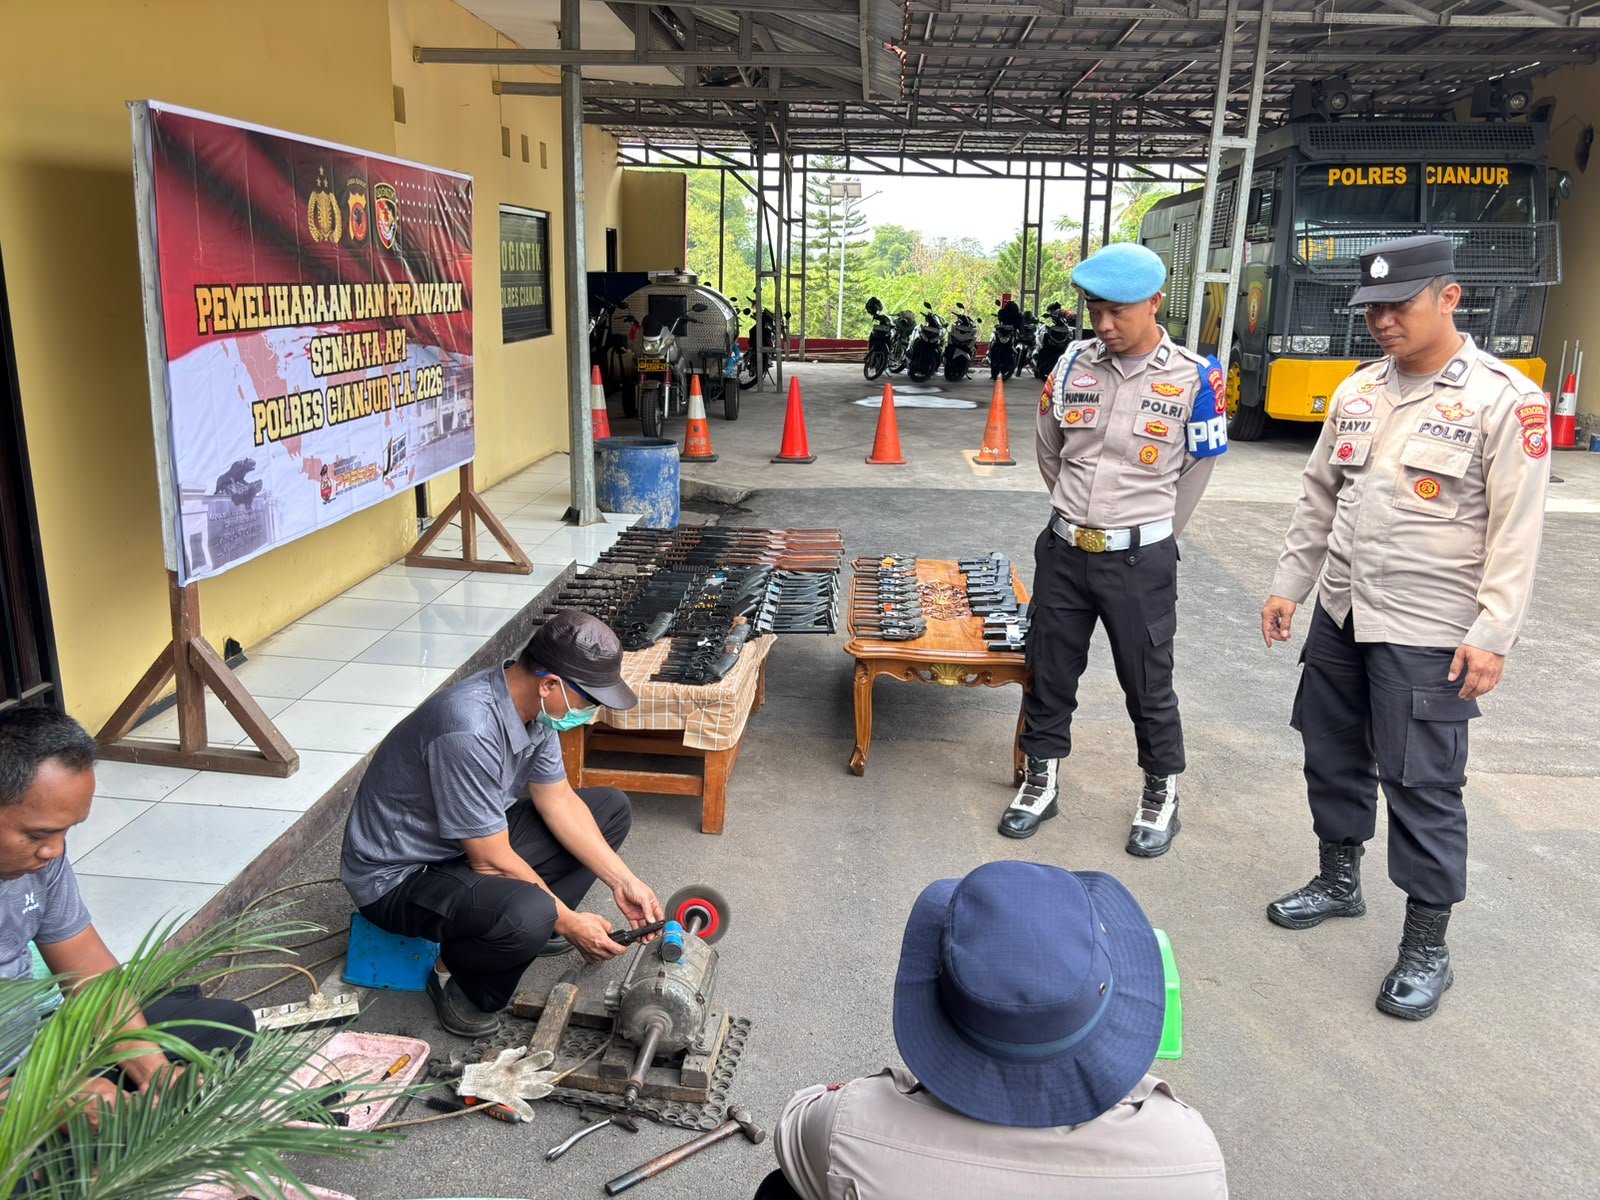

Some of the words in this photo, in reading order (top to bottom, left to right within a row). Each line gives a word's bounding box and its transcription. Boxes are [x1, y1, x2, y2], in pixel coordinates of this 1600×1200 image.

[1328, 167, 1407, 186] POLRES
[1426, 167, 1509, 185] CIANJUR
[194, 283, 352, 335] PEMELIHARAAN
[354, 283, 386, 320] DAN
[387, 282, 463, 318] PERAWATAN
[310, 334, 383, 378] SENJATA
[384, 328, 408, 365] API
[252, 389, 325, 447] POLRES
[325, 375, 392, 427] CIANJUR
[391, 369, 415, 409] T.A.
[415, 364, 444, 402] 2026
[1140, 399, 1183, 418] POLRI
[1187, 415, 1227, 452] PR
[1339, 421, 1371, 432] BAYU
[1418, 422, 1473, 444] POLRI
